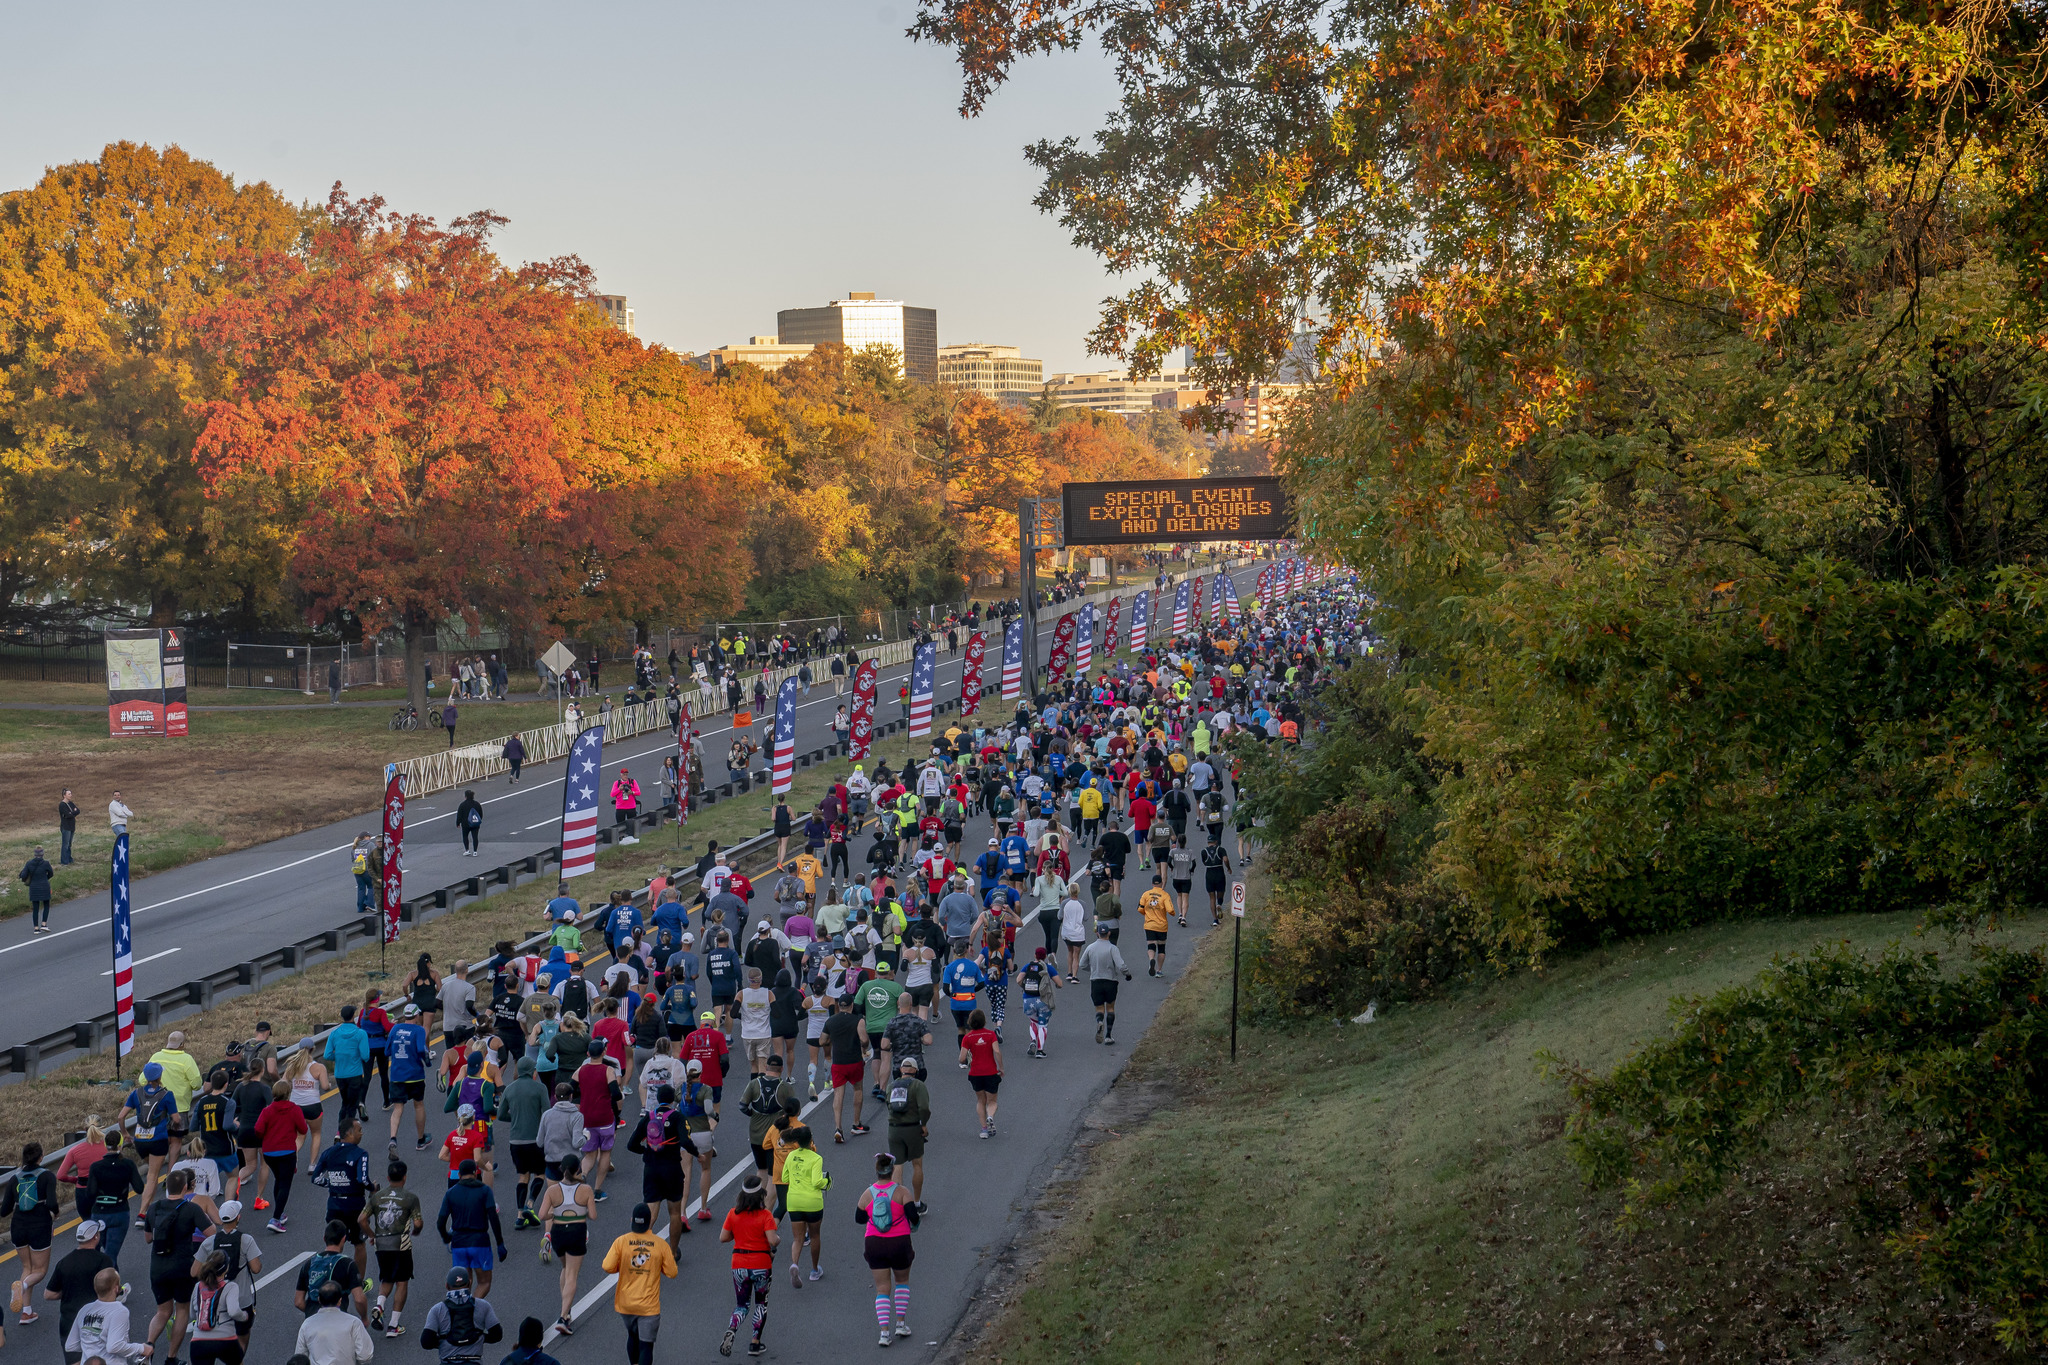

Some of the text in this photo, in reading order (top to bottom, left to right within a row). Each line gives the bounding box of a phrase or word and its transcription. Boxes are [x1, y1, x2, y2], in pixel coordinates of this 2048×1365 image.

[1105, 487, 1255, 506] SPECIAL EVENT
[1089, 501, 1272, 520] EXPECT CLOSURES
[1121, 516, 1241, 534] AND DELAYS
[711, 960, 731, 968] CAMPUS
[204, 1111, 218, 1132] 11
